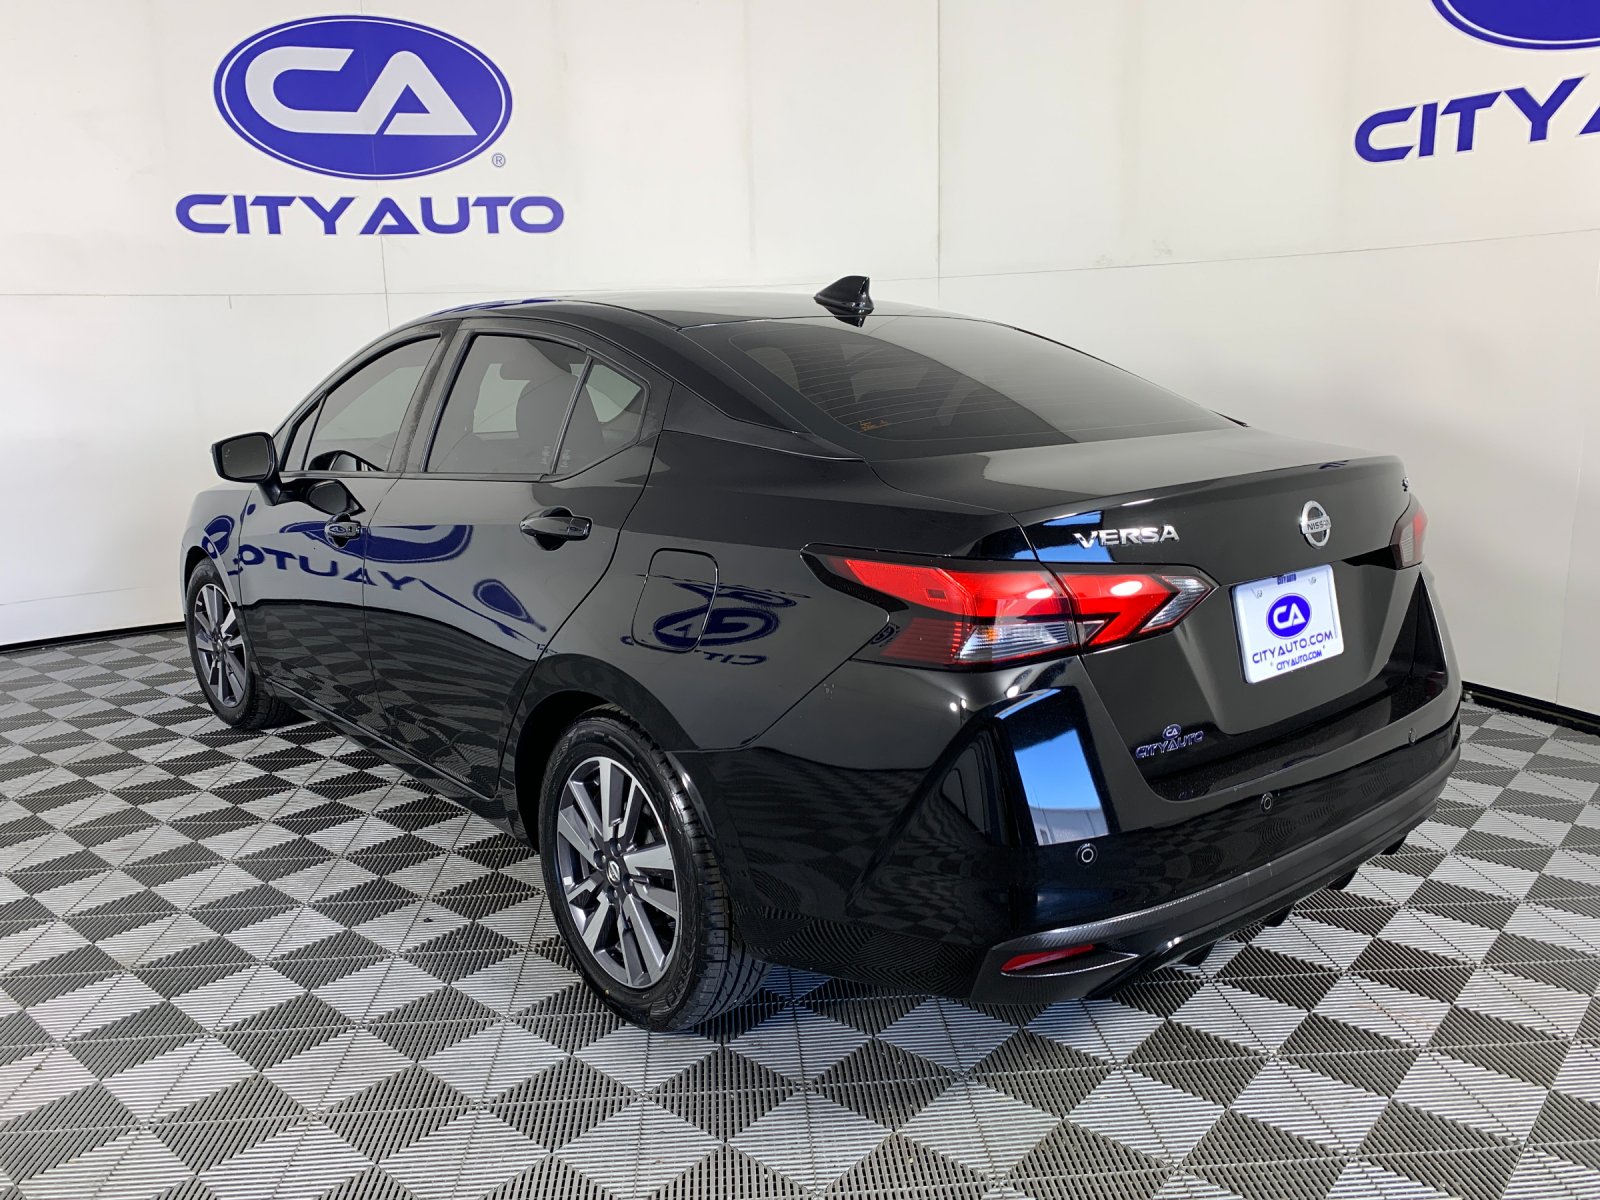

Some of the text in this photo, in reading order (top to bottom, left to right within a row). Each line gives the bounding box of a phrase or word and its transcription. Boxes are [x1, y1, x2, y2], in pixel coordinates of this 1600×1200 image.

[245, 46, 478, 136] CA
[1354, 76, 1586, 163] CITY
[1072, 524, 1180, 549] VERSA
[1272, 602, 1307, 630] CA
[1252, 630, 1334, 664] CITYAUTO.COM
[1276, 649, 1323, 671] CITYAUTO.COM
